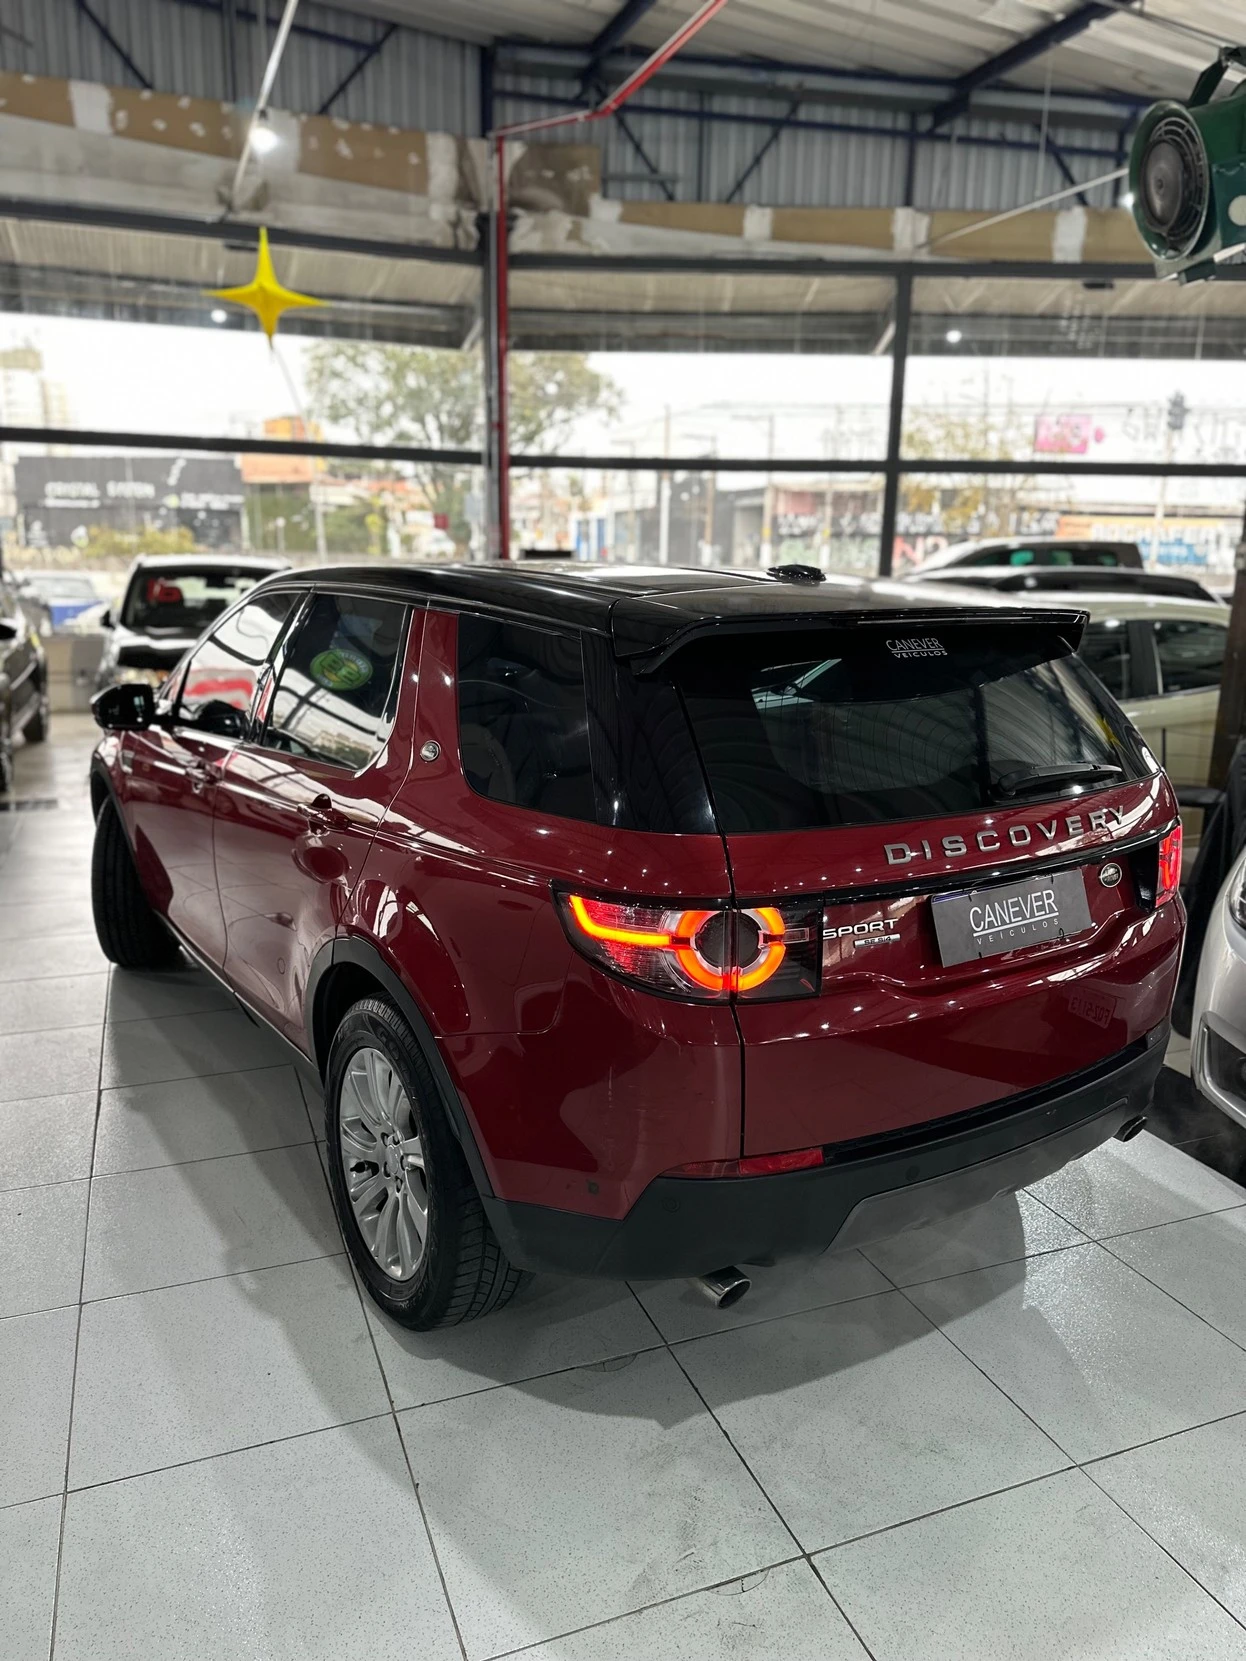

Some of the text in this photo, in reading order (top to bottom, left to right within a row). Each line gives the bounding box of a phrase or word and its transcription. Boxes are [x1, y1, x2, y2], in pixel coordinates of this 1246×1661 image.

[885, 637, 943, 651] CANEVER
[884, 806, 1125, 864] DISCOVERY
[969, 889, 1058, 932] CANEVER
[822, 918, 899, 940] SPORT
[976, 917, 1060, 945] VEICULOS
